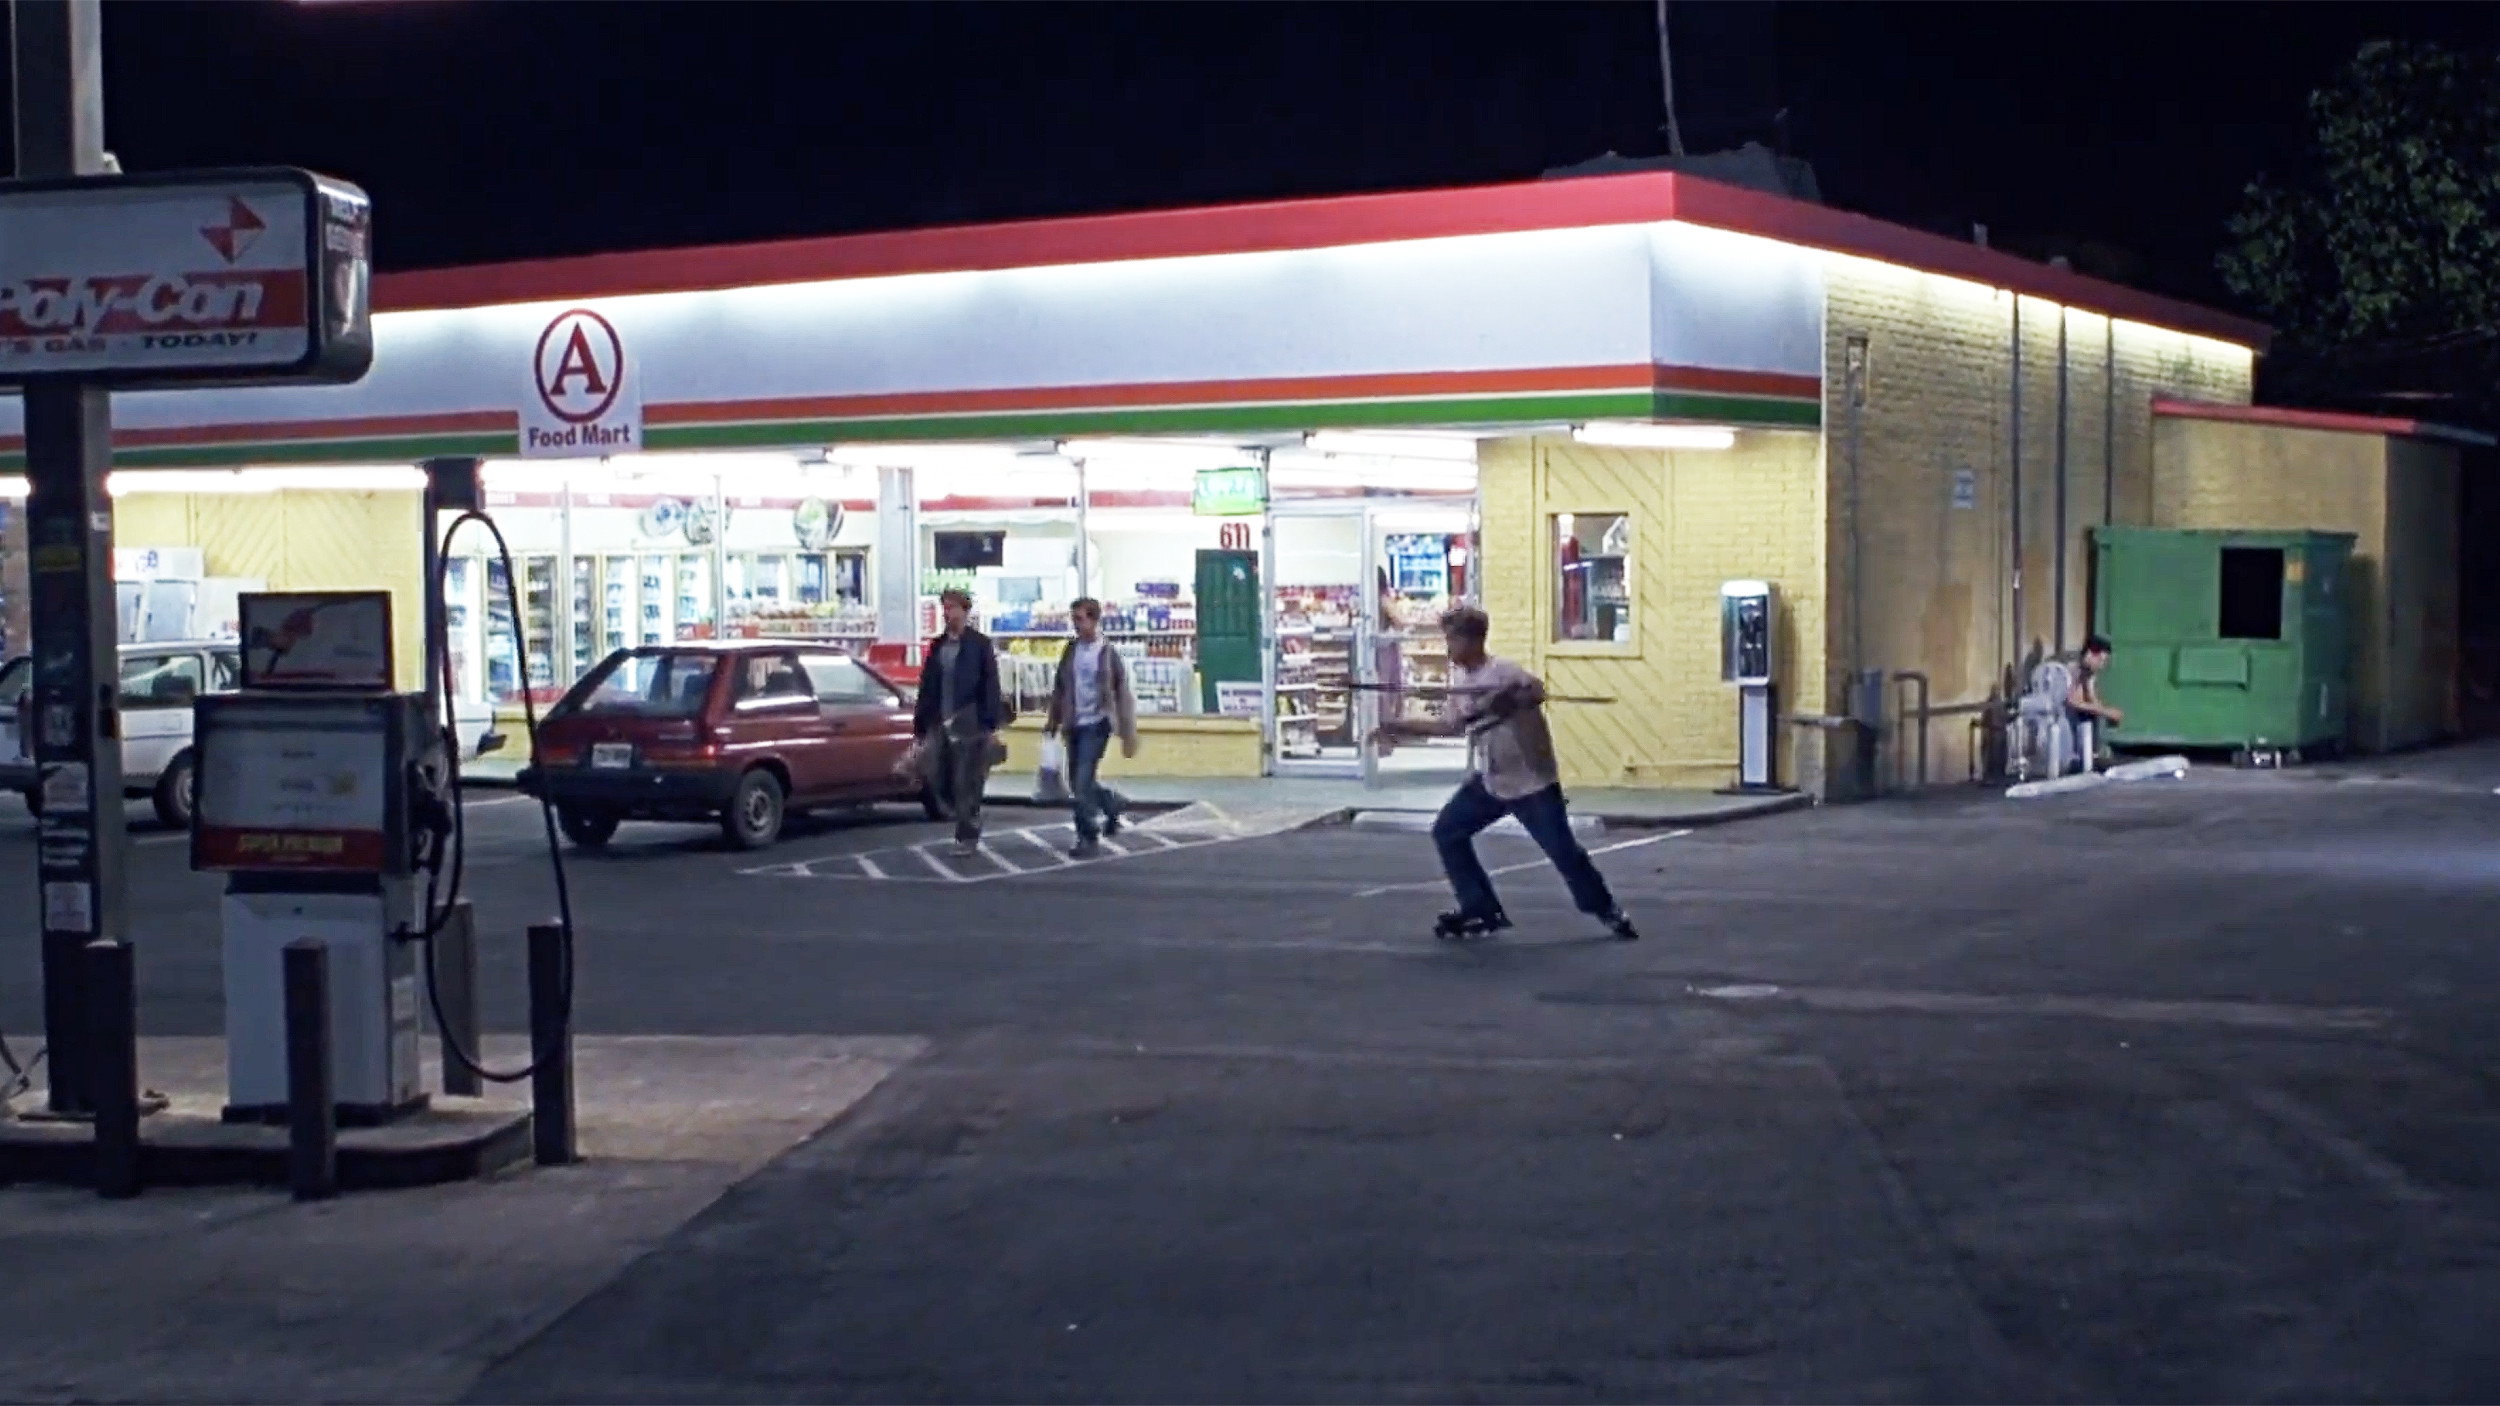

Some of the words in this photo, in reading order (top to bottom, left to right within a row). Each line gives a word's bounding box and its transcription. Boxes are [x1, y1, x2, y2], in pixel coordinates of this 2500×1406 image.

[143, 331, 257, 349] TODAY!
[550, 321, 607, 396] A
[528, 424, 577, 448] Food
[582, 422, 630, 446] Mart
[1220, 522, 1250, 550] 611
